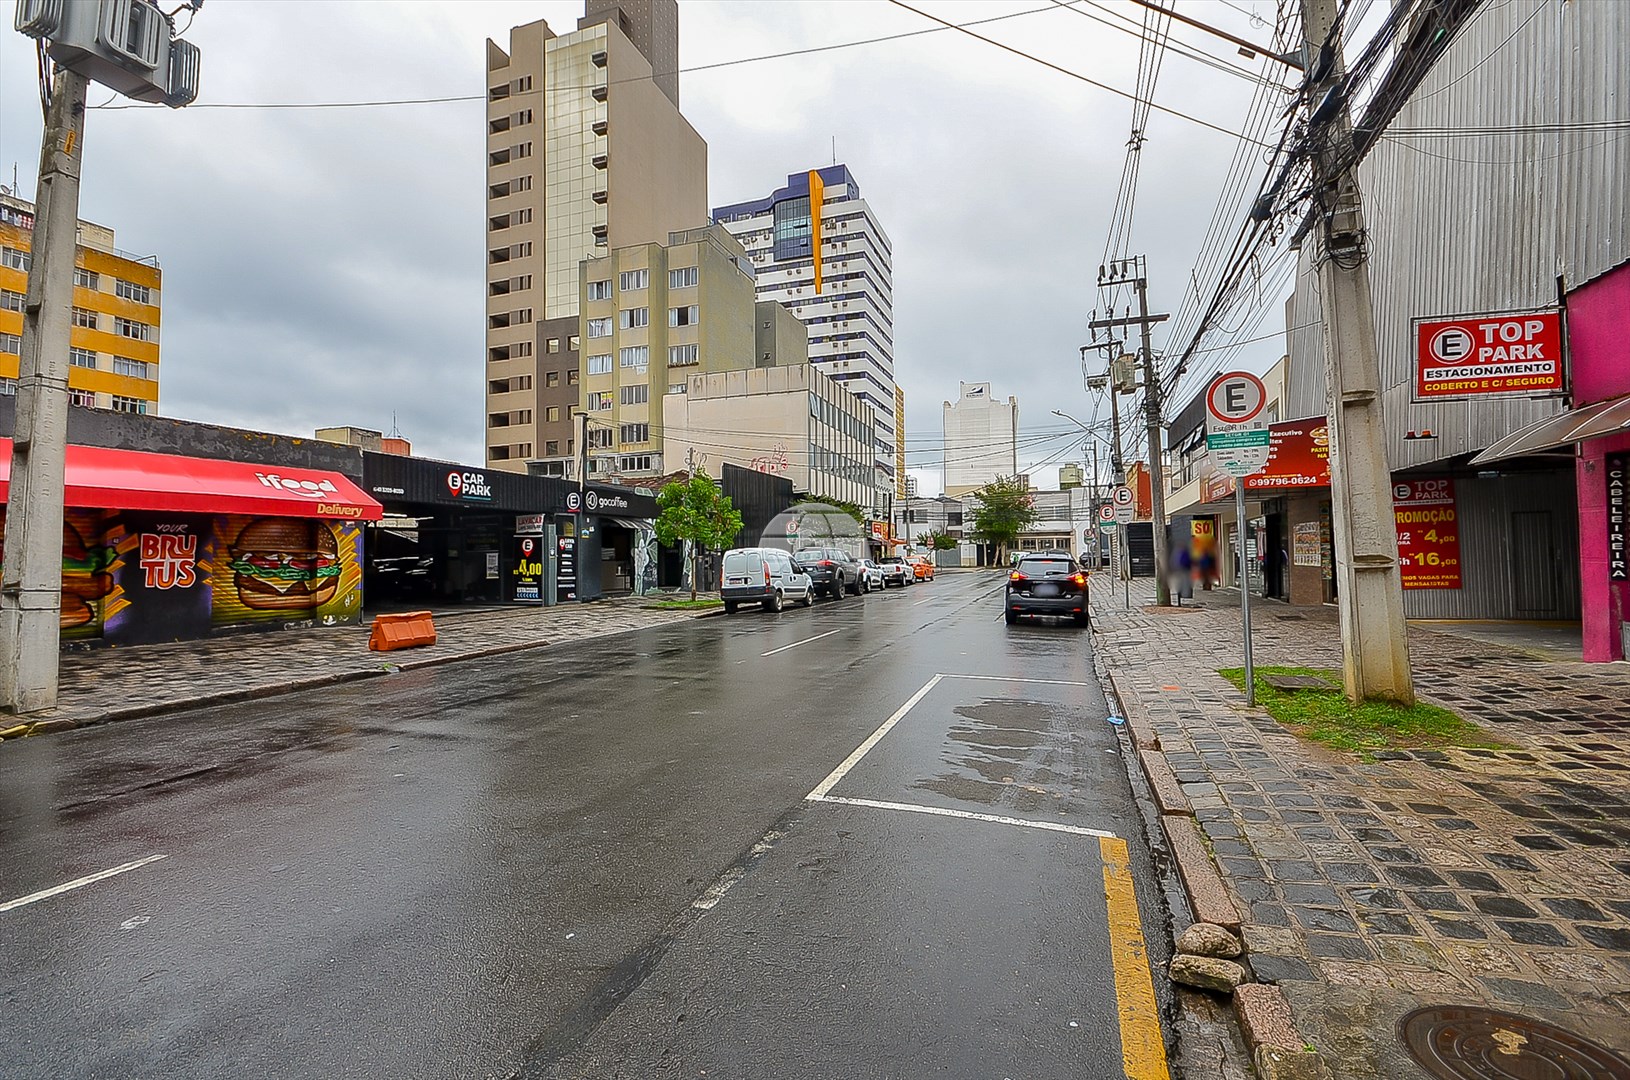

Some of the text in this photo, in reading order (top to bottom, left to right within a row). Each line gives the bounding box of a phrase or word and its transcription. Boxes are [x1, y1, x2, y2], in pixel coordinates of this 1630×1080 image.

[1479, 320, 1544, 344] TOP
[1441, 333, 1462, 357] E
[1479, 343, 1545, 362] PARK
[1426, 363, 1552, 379] ESTACIONAMENTO
[1424, 376, 1555, 392] COBERTO E C/ SEGURO
[1226, 383, 1247, 412] E
[1269, 429, 1303, 437] Executivo
[255, 472, 338, 493] ifood
[451, 475, 460, 488] E
[462, 472, 485, 486] CAR
[1257, 476, 1317, 487] 99796-0624
[1414, 480, 1449, 492] TOP
[462, 483, 492, 497] PARK
[1119, 490, 1127, 501] E
[1396, 485, 1407, 497] E
[1415, 490, 1449, 500] PARK
[570, 495, 577, 507] E
[598, 496, 628, 508] gocoffee
[317, 503, 363, 518] Delivery
[1104, 508, 1110, 516] E
[156, 524, 189, 533] YOUR
[1609, 470, 1626, 578] CABELEIREIRA
[140, 533, 197, 560] BRU
[524, 541, 531, 551] E
[140, 559, 197, 590] TUS
